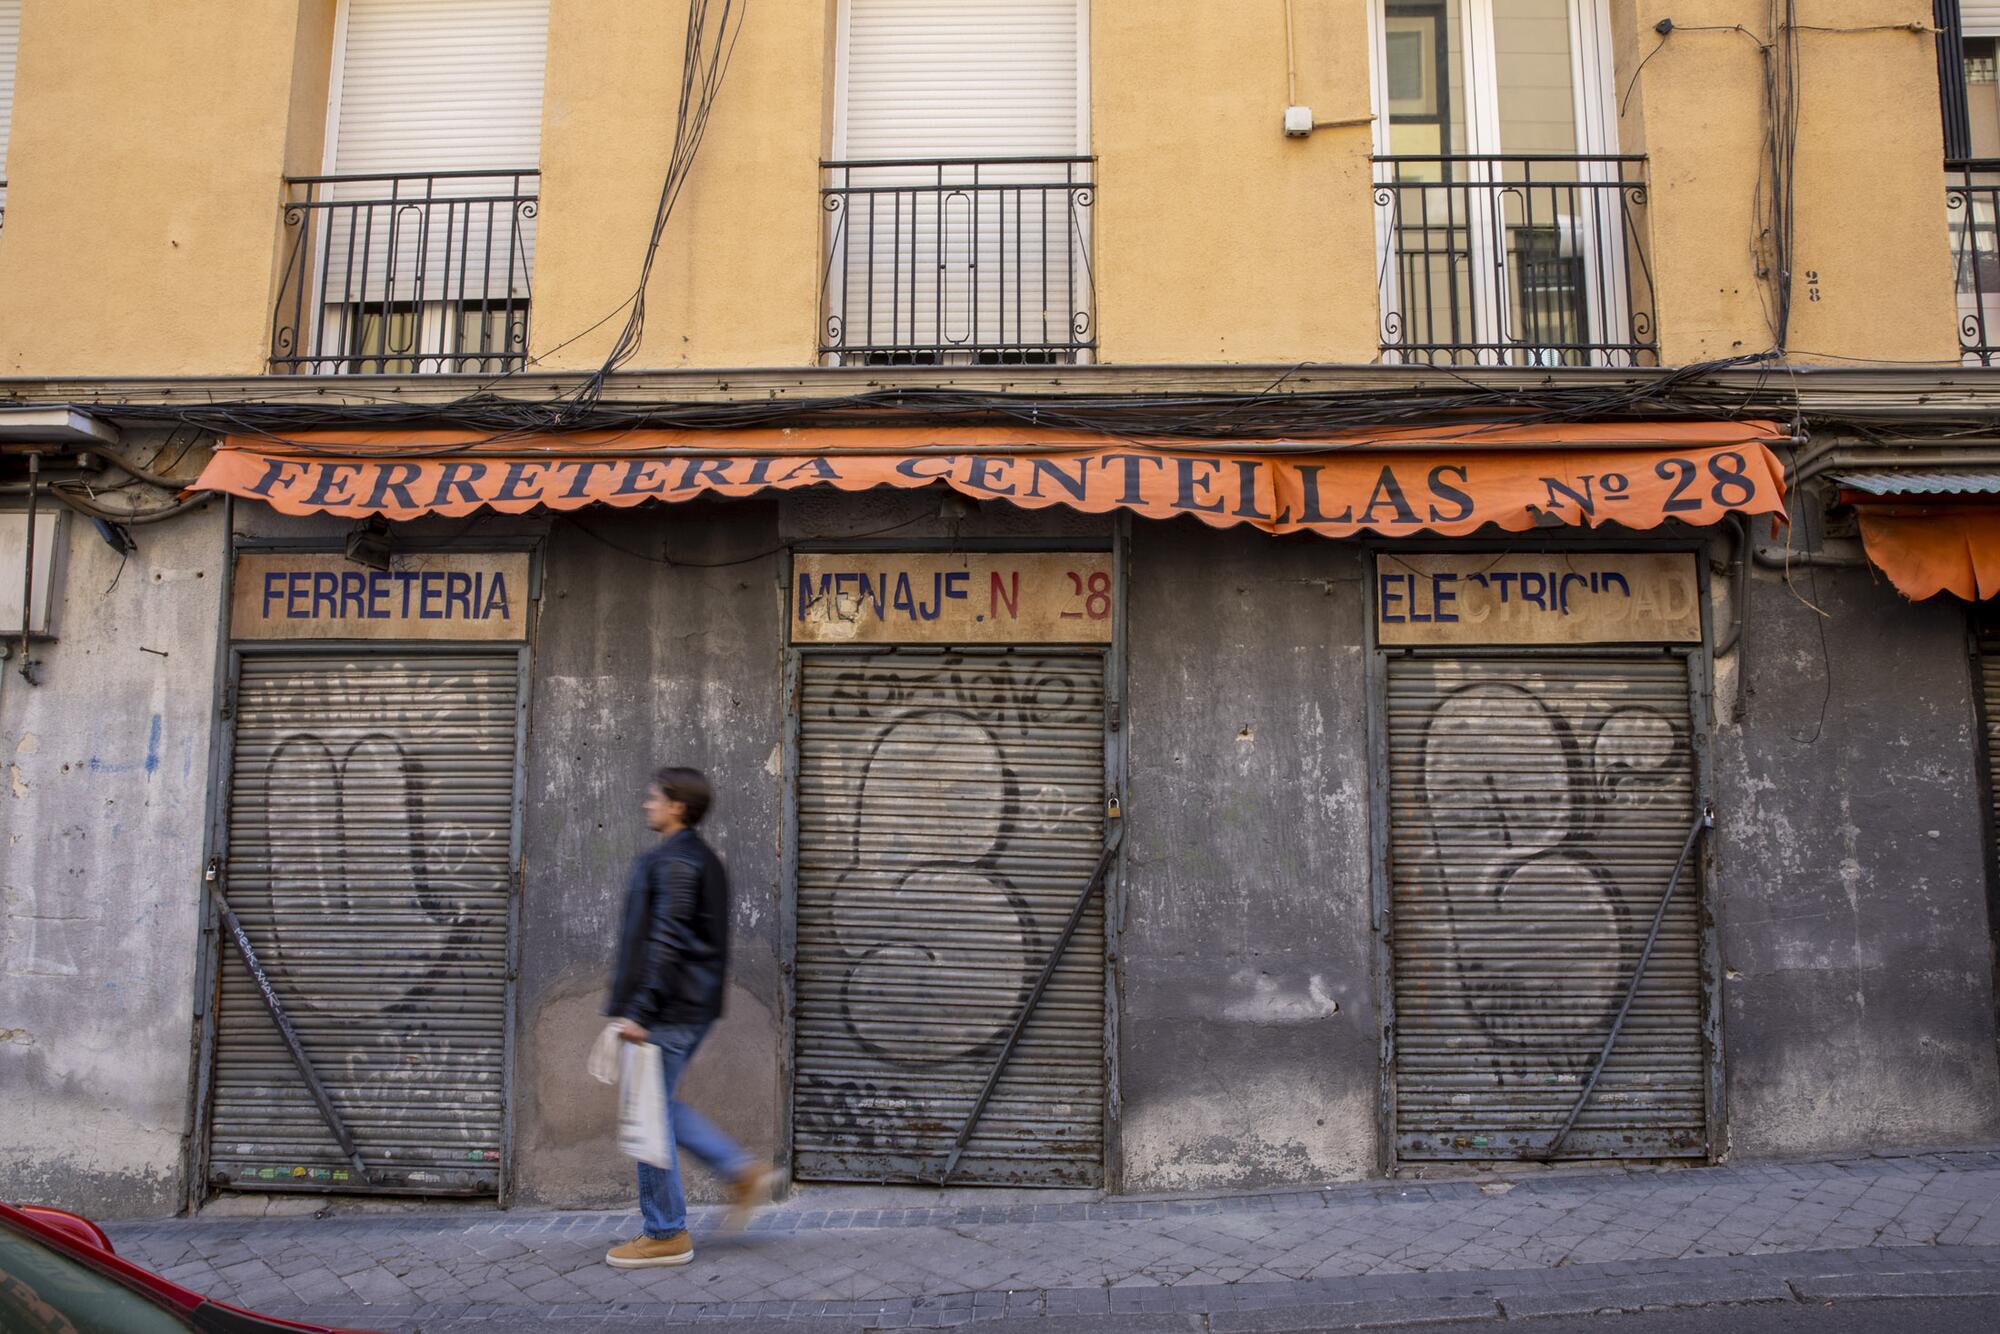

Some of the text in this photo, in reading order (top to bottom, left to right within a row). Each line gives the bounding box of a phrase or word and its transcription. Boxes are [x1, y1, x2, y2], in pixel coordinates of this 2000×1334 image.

[1805, 271, 1821, 302] 28
[243, 457, 843, 508] FERRETERIA
[895, 453, 1475, 523] CENTELLAS
[1654, 451, 1756, 513] 28
[262, 571, 511, 620] FERRETERIA
[1059, 571, 1112, 620] 28
